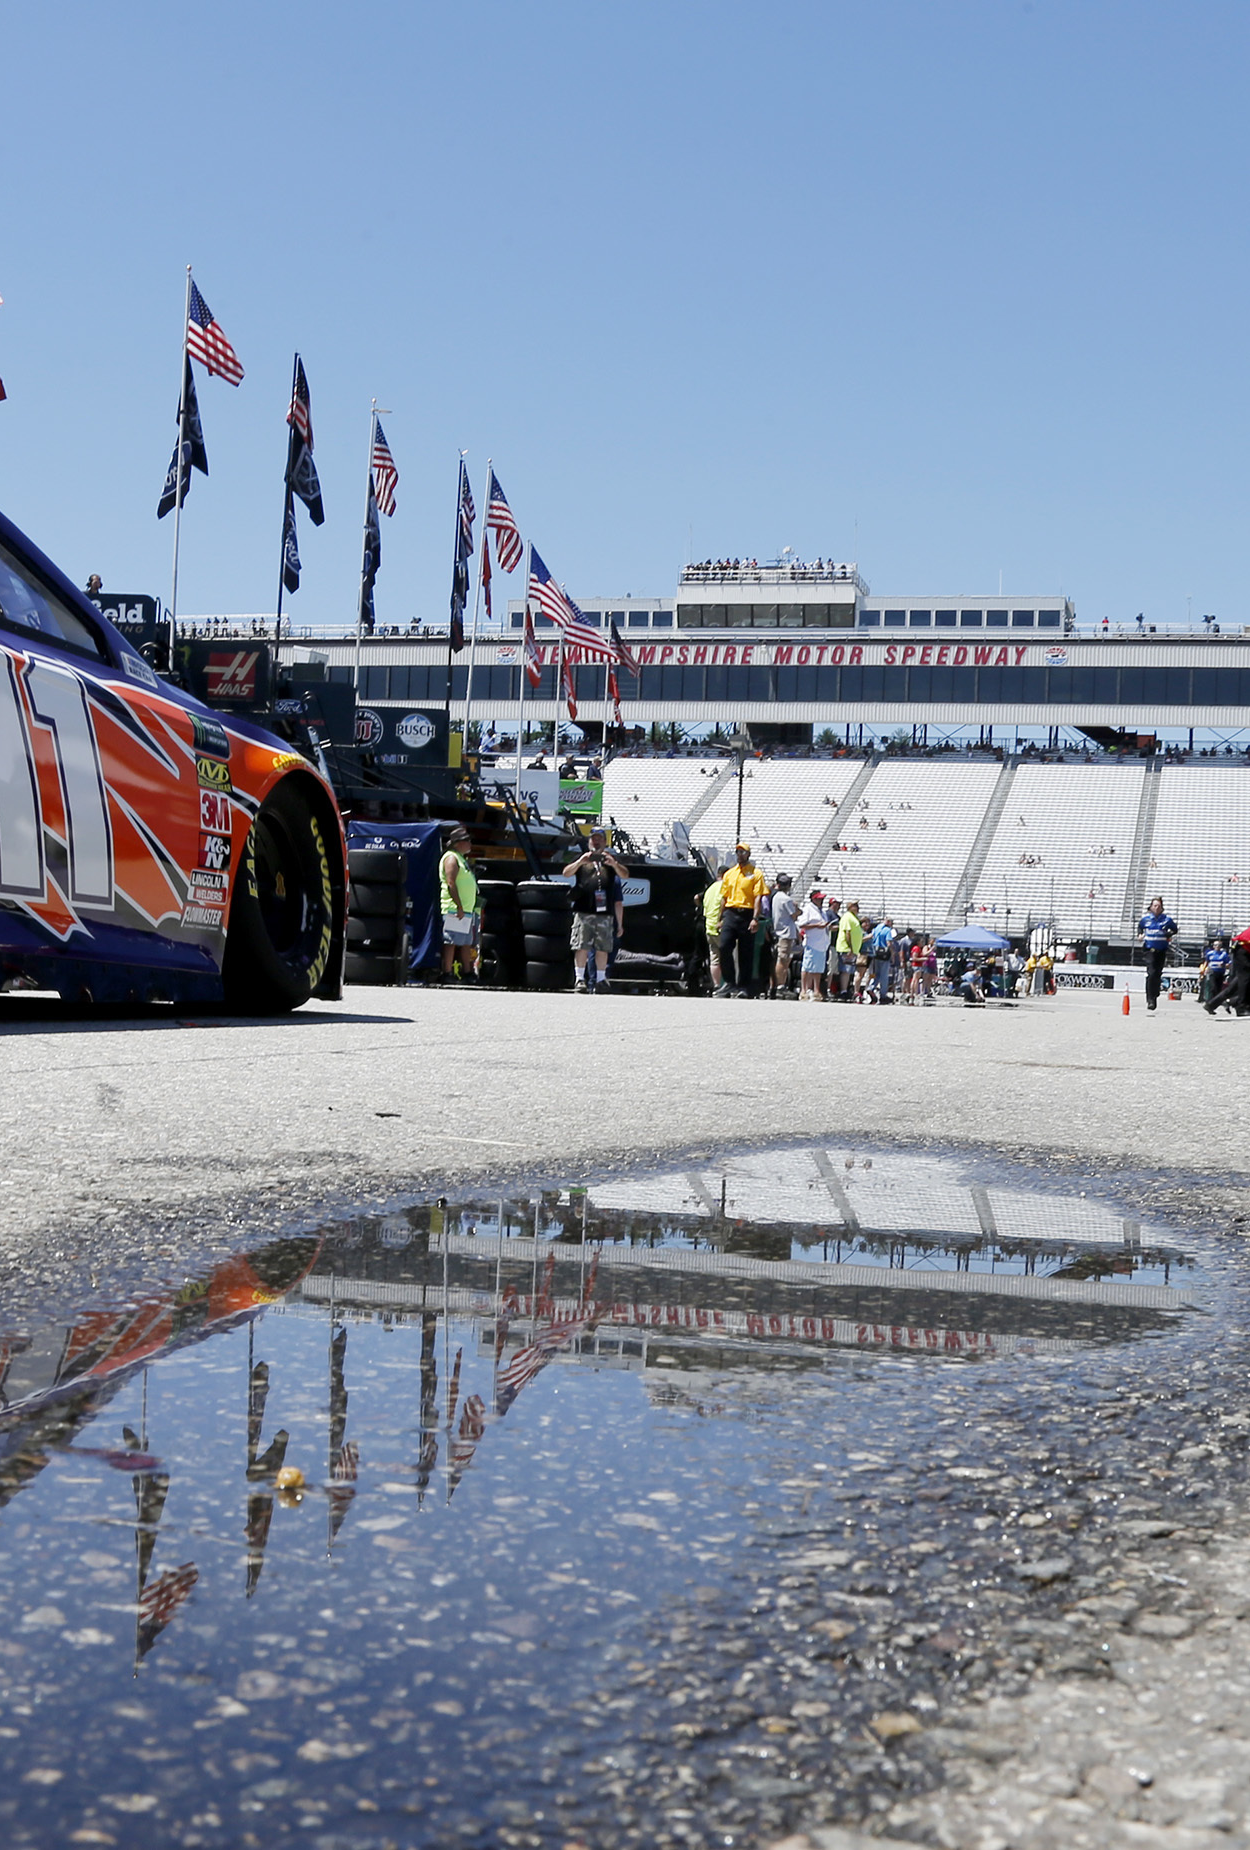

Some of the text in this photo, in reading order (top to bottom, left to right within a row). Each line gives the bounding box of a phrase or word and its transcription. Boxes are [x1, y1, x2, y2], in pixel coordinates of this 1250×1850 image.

[773, 645, 864, 665] MOTOR
[884, 645, 1028, 665] SPEEDWAY
[208, 682, 255, 696] HAAS
[397, 724, 436, 738] BUSCH
[201, 793, 230, 832] 3M
[192, 873, 222, 888] LINCOLN
[196, 888, 223, 901] WELDERS
[181, 906, 222, 927] FLOWMASTER
[1053, 974, 1106, 985] FOXWOODS
